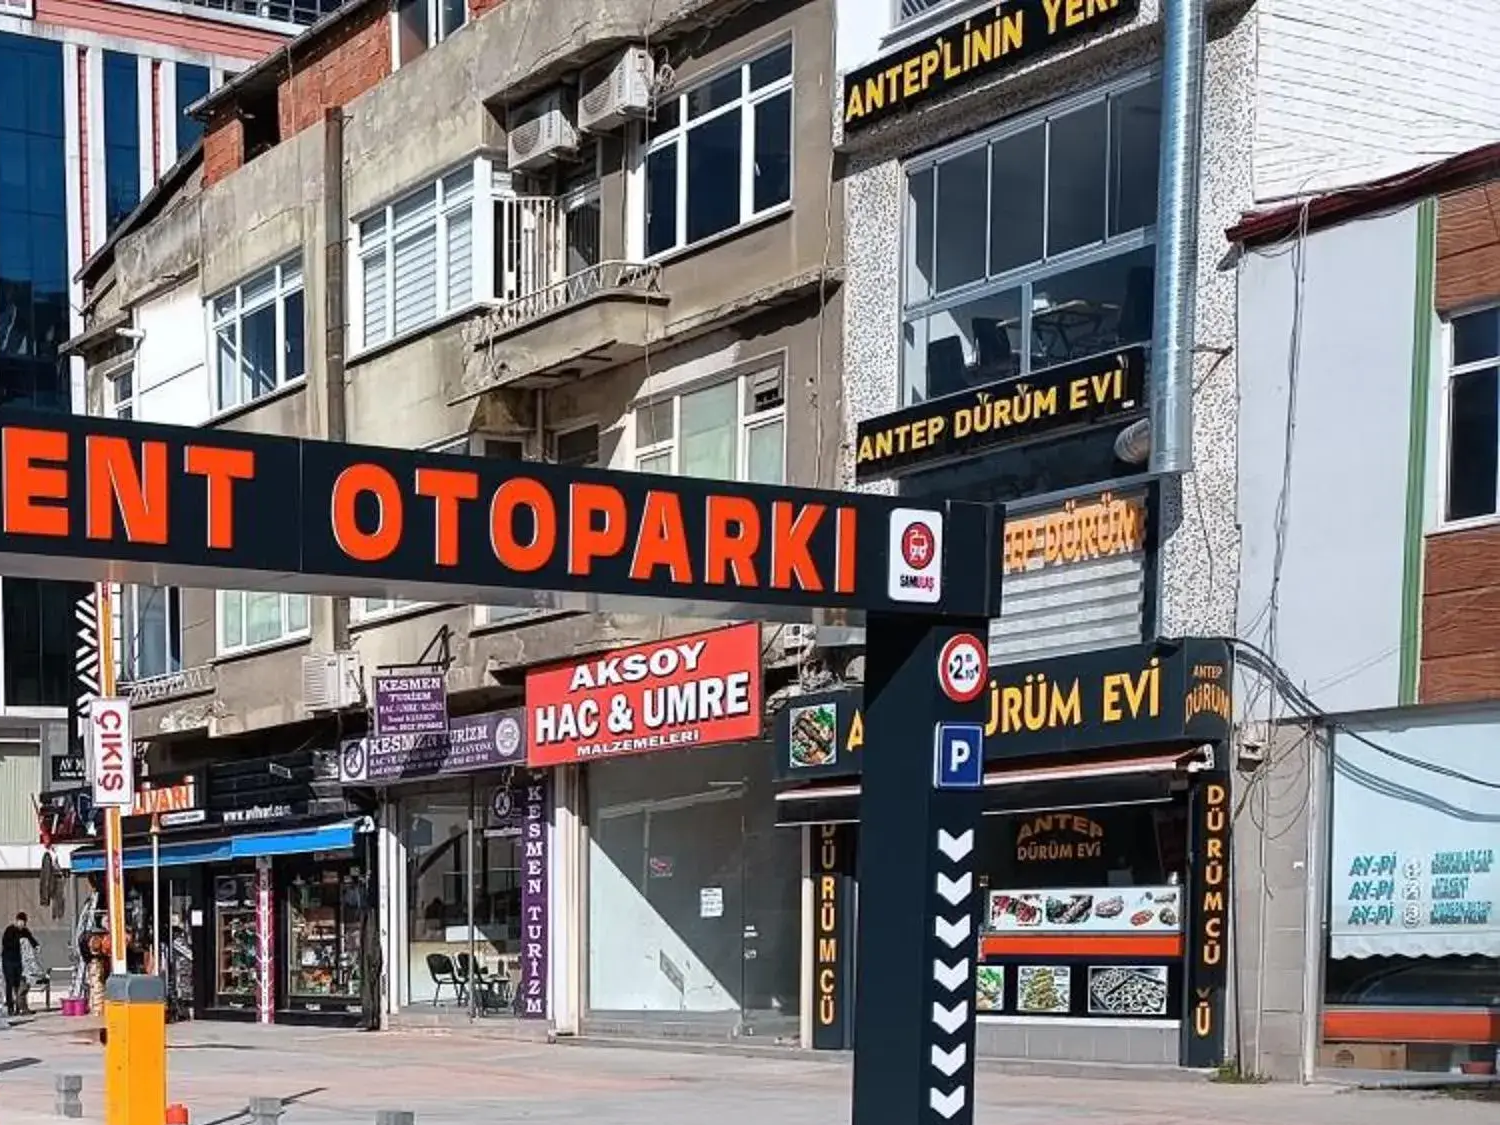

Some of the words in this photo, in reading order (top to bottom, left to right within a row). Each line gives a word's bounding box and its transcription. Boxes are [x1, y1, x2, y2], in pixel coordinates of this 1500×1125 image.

[1040, 0, 1120, 34] YE
[857, 415, 945, 463] ANTEP
[954, 384, 1057, 439] DÜRÜM
[331, 463, 857, 594] OTOPARKI
[378, 677, 441, 693] KESMEN
[570, 640, 706, 693] AKSOY
[1102, 657, 1160, 722] EVİ
[535, 698, 599, 744] HAC
[607, 693, 633, 734] &
[643, 671, 751, 728] UMRE
[95, 709, 124, 792] ÇIKIŞ
[951, 740, 971, 772] P
[525, 786, 543, 894] KESMEN
[1016, 813, 1104, 844] ANTEP
[1017, 841, 1073, 861] DÜRÜM
[1203, 785, 1225, 965] DÜRÜMCÜ
[525, 906, 543, 1014] TURİZM
